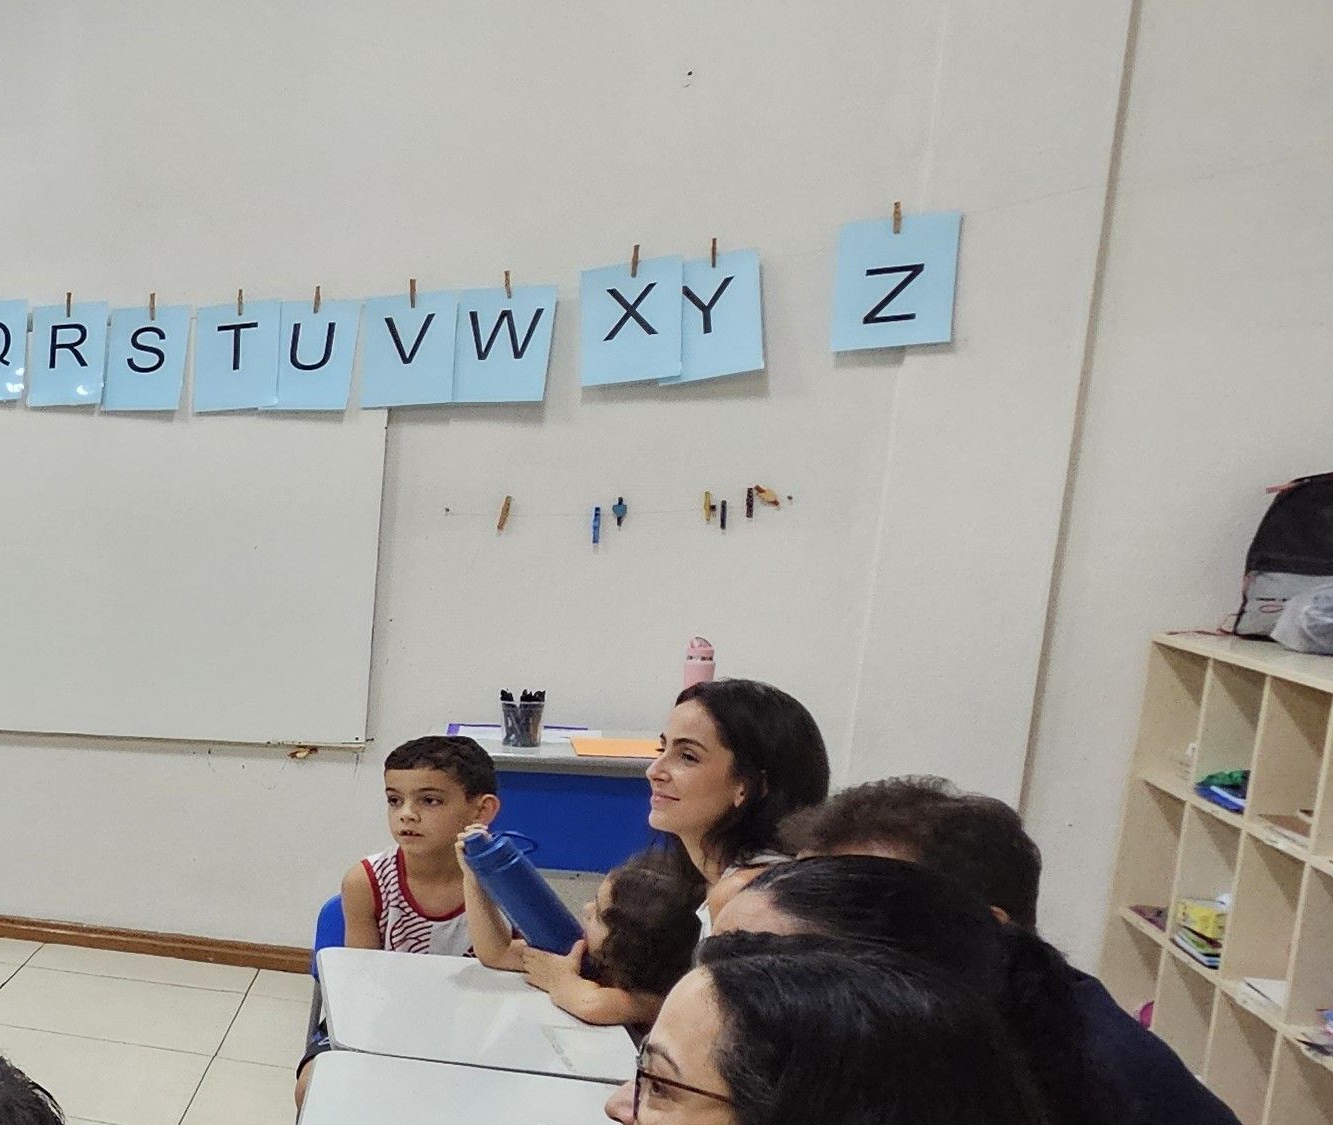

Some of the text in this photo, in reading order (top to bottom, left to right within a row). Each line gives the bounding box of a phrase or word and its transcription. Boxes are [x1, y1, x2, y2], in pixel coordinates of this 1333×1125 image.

[48, 323, 89, 369] R
[126, 326, 166, 374] S
[217, 321, 259, 371] T
[289, 322, 336, 371] U
[384, 313, 436, 365] V
[469, 307, 545, 361] W
[603, 282, 659, 342] X
[681, 275, 735, 335] Y
[862, 263, 925, 325] Z
